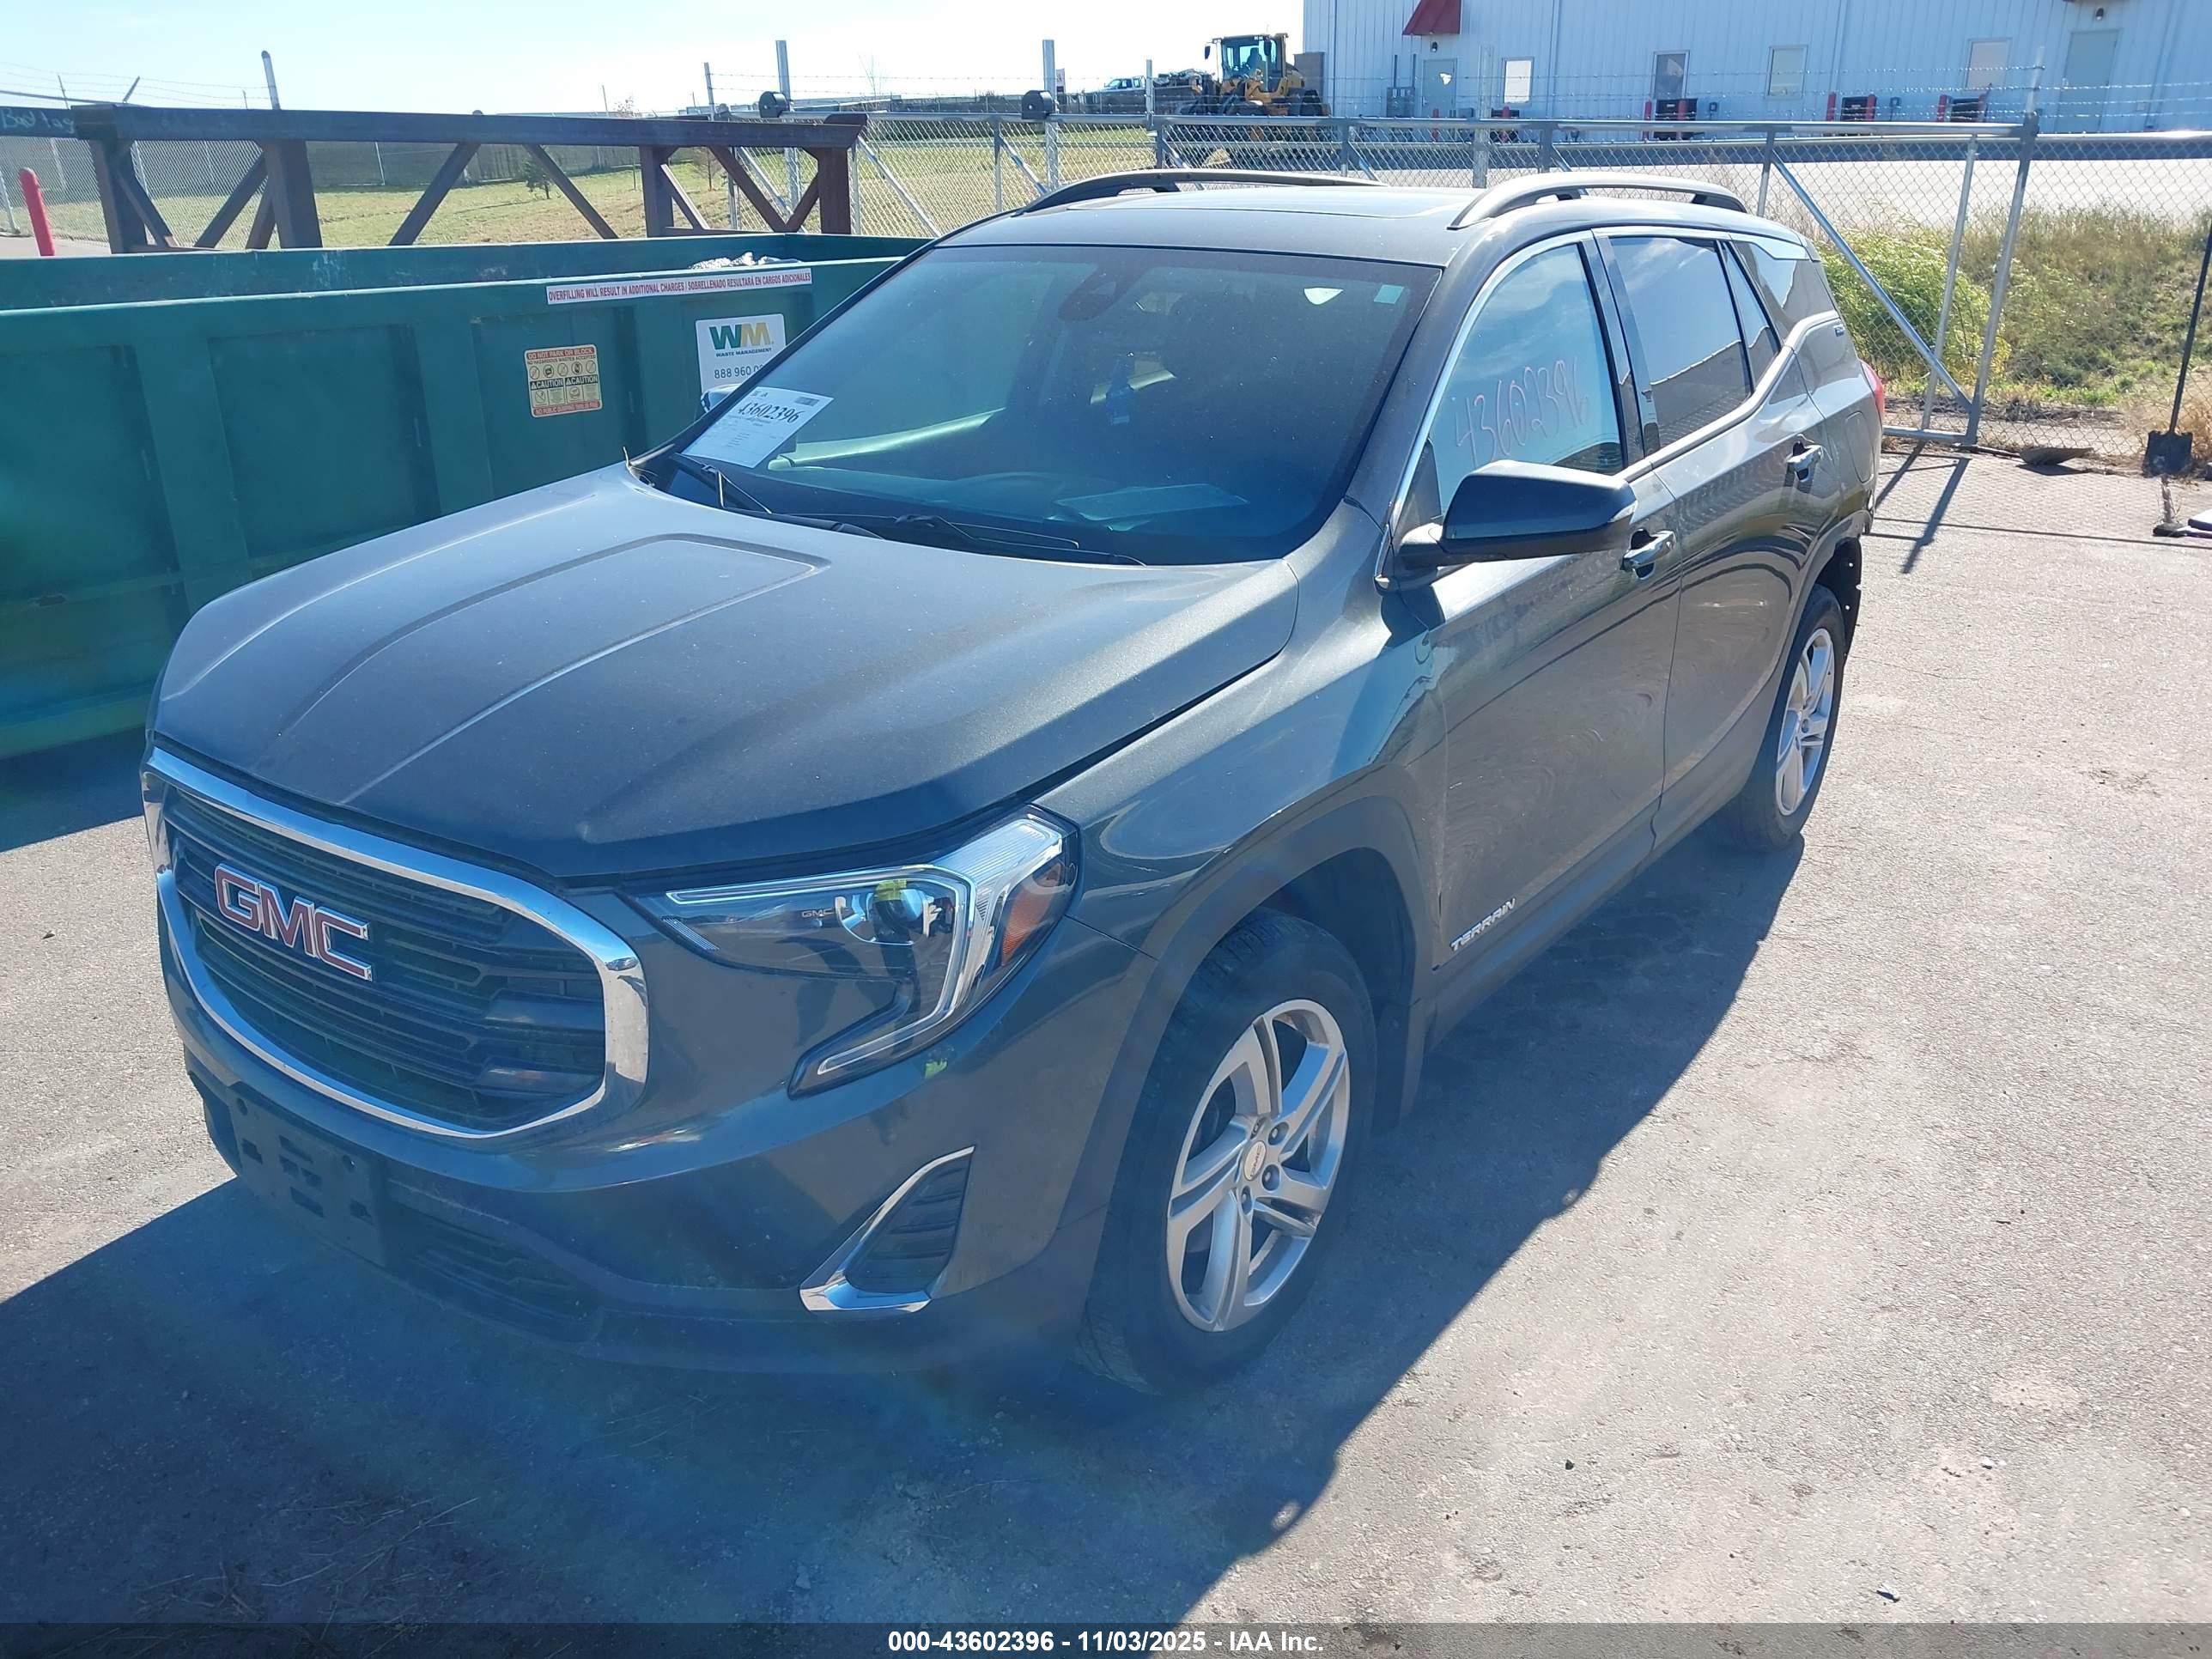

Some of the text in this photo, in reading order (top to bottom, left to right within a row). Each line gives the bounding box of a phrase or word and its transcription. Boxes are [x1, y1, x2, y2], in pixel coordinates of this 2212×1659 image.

[549, 288, 585, 301] OVERFILLING
[585, 287, 599, 298] WILL
[600, 286, 621, 297] RESULT
[622, 285, 628, 295] IN
[629, 283, 659, 295] ADDITIONAL
[660, 282, 684, 292] CHARGES
[688, 279, 726, 290] SOBRELLENADO
[756, 276, 762, 285] EN
[763, 275, 781, 285] CARGOS
[781, 272, 811, 283] ADICIONALES
[709, 323, 771, 350] WM
[574, 347, 592, 356] BLOCK
[536, 378, 563, 388] CAUTION
[570, 375, 598, 385] CAUTION
[714, 368, 732, 380] 888
[734, 366, 751, 377] 960
[738, 402, 805, 423] 43602396
[215, 863, 373, 981] GMC
[1449, 897, 1516, 951] TERRAIN
